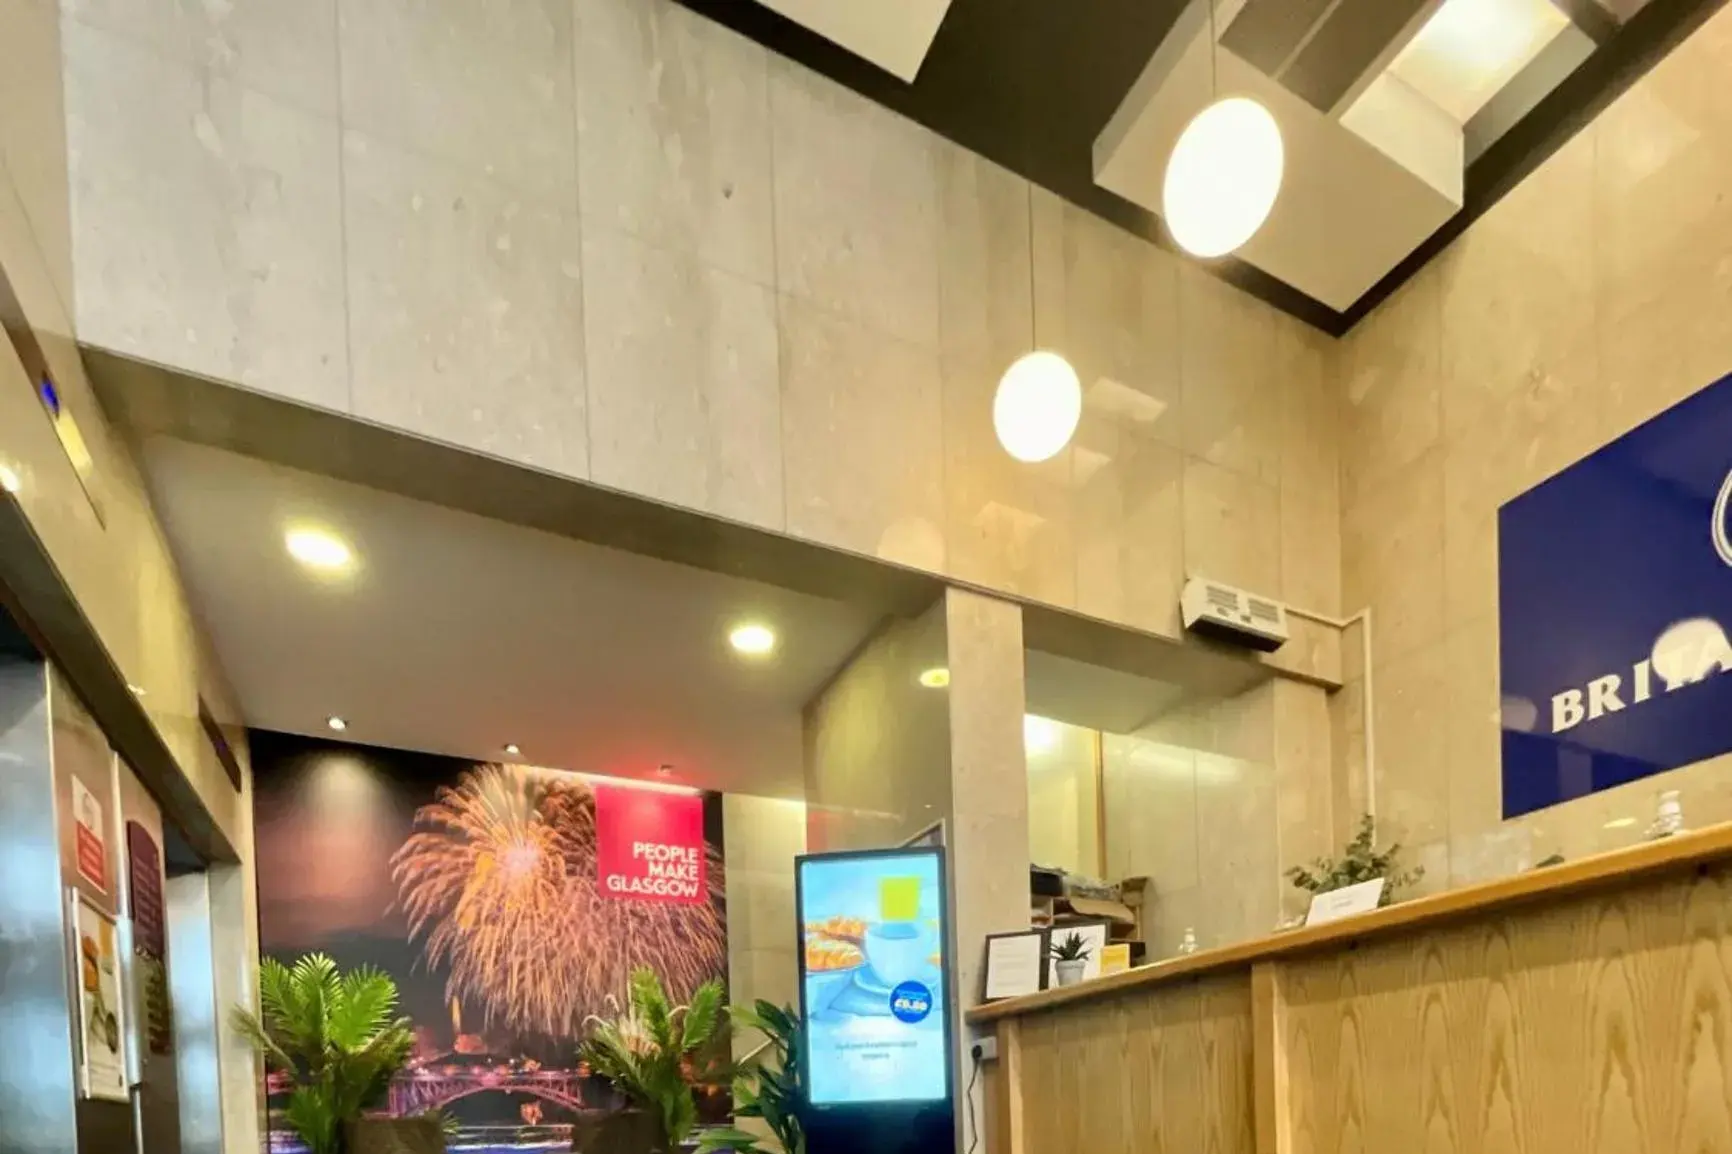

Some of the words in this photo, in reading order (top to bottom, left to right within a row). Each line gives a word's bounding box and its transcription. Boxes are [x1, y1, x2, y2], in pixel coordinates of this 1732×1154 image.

[633, 842, 698, 863] PEOPLE
[649, 861, 698, 880] MAKE
[607, 874, 699, 897] GLASGOW
